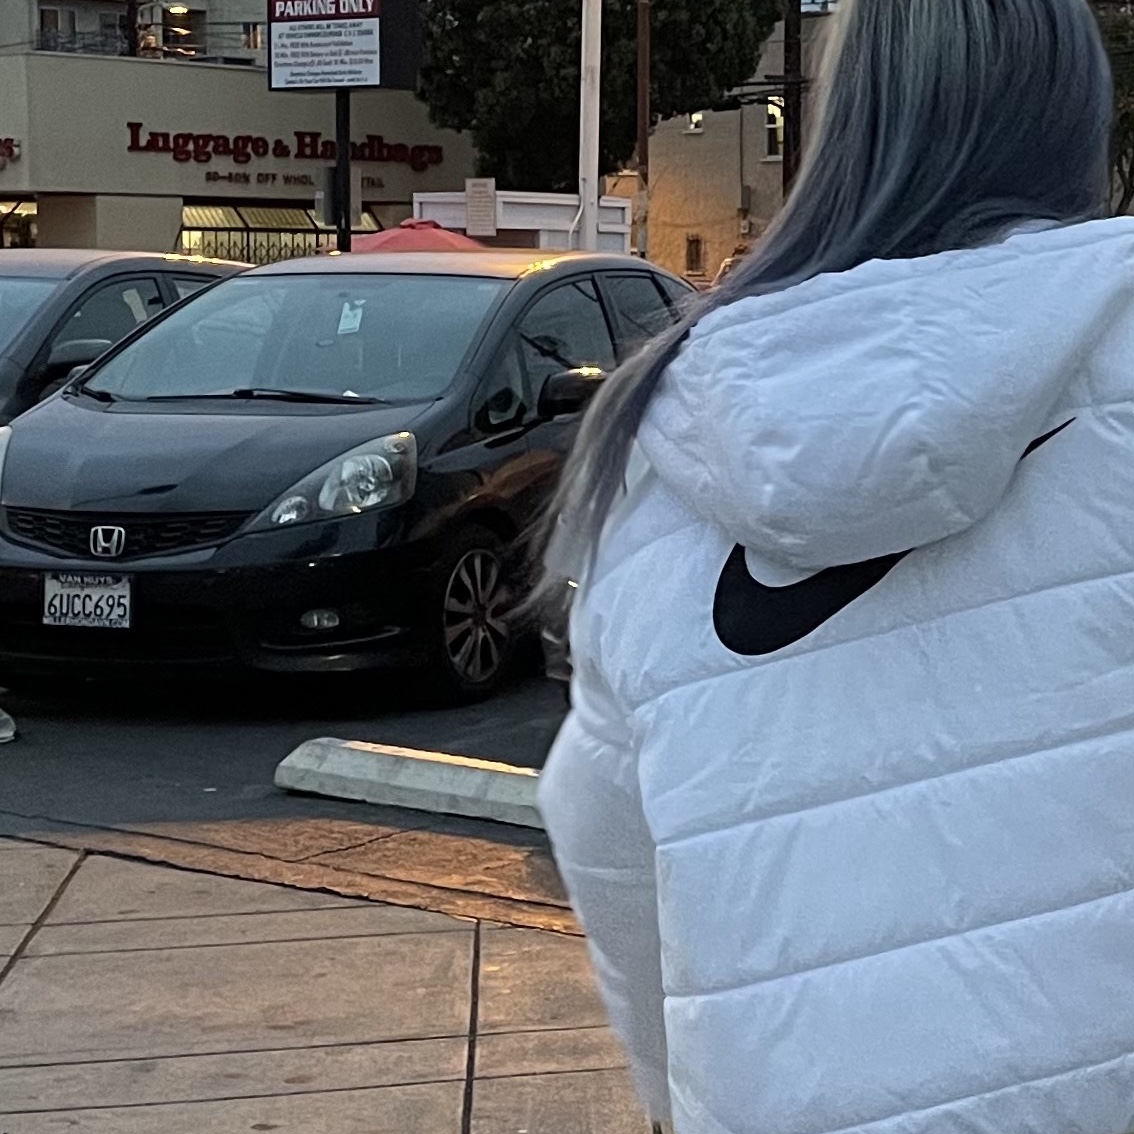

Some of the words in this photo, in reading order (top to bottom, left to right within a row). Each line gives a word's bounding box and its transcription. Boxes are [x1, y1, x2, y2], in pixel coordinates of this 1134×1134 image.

[275, 0, 336, 17] PARKING
[339, 0, 373, 13] ONLY
[127, 122, 269, 164] Luggage
[272, 138, 290, 157] &
[256, 172, 278, 184] OFF
[59, 574, 83, 584] VAN
[47, 593, 128, 618] 6UCC695
